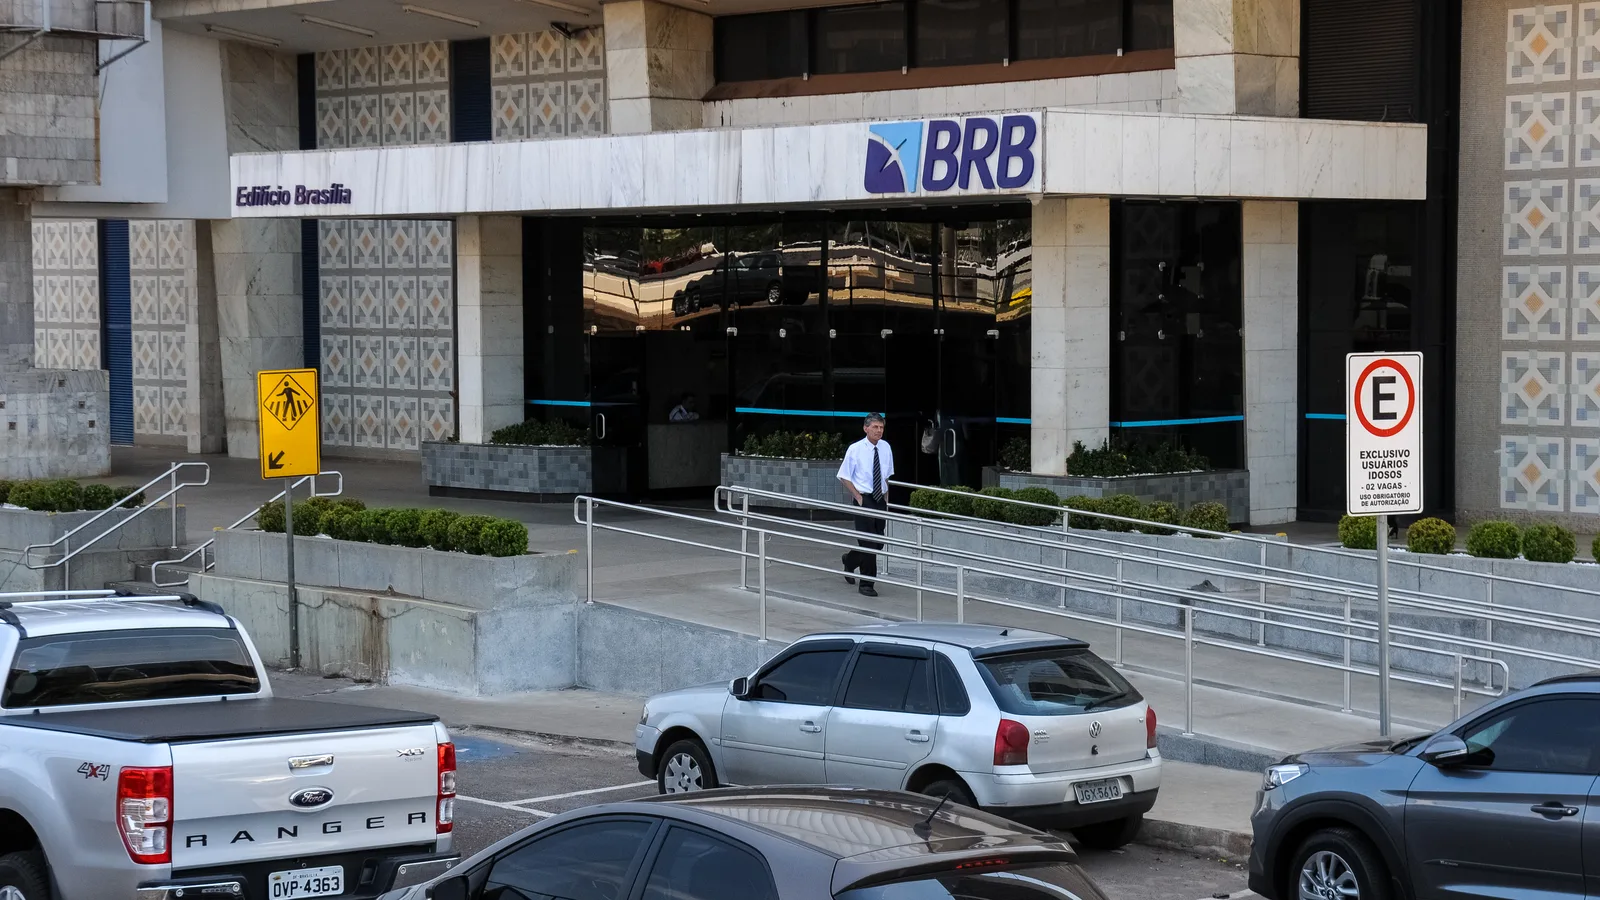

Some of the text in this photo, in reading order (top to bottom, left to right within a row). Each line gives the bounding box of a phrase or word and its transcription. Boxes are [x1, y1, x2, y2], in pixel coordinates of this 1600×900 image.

[922, 115, 1037, 191] BRB
[236, 183, 352, 206] Edifício Brasília
[1372, 376, 1397, 420] E
[1360, 449, 1410, 459] EXCLUSIVO
[1362, 459, 1408, 469] USUÁRIOS
[1368, 470, 1402, 480] IDOSOS
[1377, 482, 1402, 490] VAGAS
[1370, 498, 1409, 506] AUTORIZAÇÃO
[301, 791, 326, 803] Ford
[186, 811, 427, 848] RANGER
